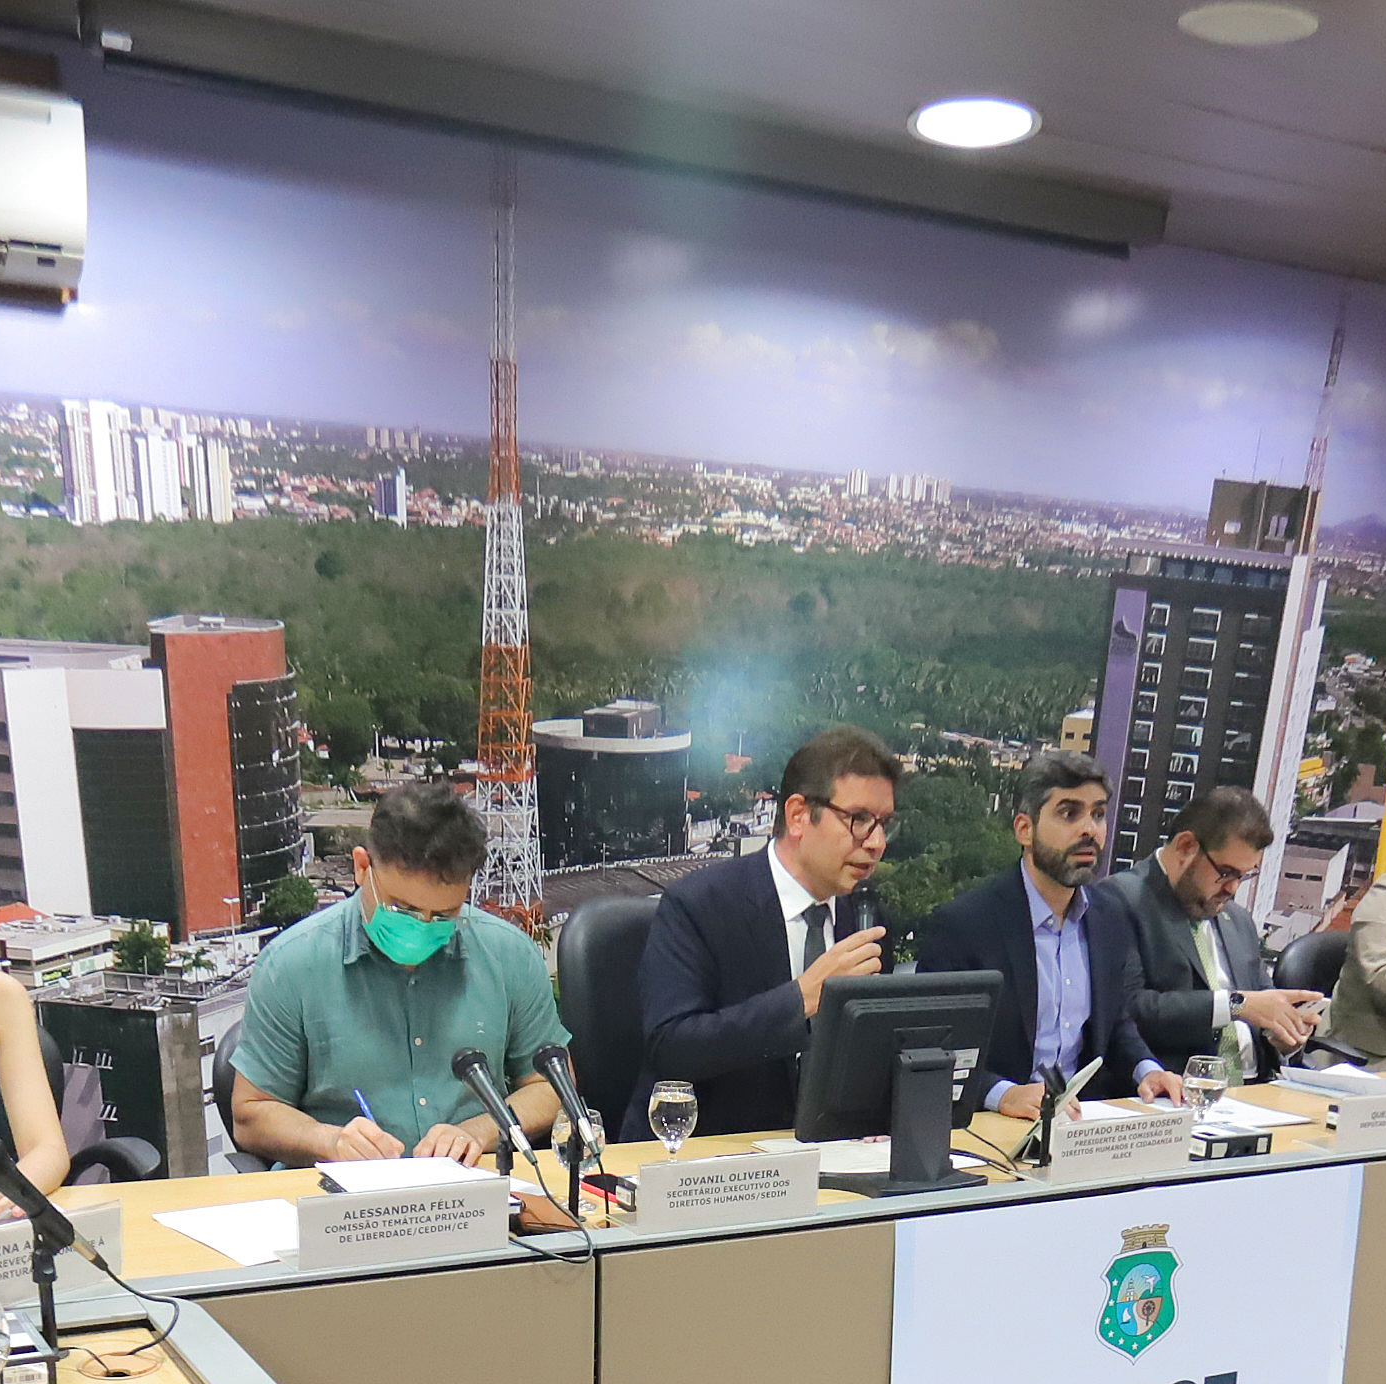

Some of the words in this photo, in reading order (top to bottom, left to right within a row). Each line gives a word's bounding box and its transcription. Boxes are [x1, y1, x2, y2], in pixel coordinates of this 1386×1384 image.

[1067, 1125, 1112, 1139] DEPUTADO
[1114, 1121, 1147, 1133] RENATO
[1150, 1117, 1183, 1128] ROSENO
[1074, 1135, 1116, 1148] PRESIDENTE
[1117, 1134, 1127, 1142] DA
[1128, 1129, 1163, 1140] COMISSÃO
[1164, 1128, 1173, 1136] DE
[1061, 1148, 1094, 1158] DIREITOS
[1095, 1143, 1128, 1154] HUMANOS
[1135, 1138, 1172, 1148] CIDADANIA
[678, 1175, 726, 1187] JOVANIL
[729, 1169, 780, 1182] OLIVEIRA
[666, 1185, 721, 1199] SECRETÁRIO
[723, 1181, 770, 1193] EXECUTIVO
[772, 1179, 790, 1188] DOS
[343, 1203, 426, 1220] ALESSANDRA
[430, 1198, 465, 1211] FÉLIX
[669, 1198, 711, 1209] DIREITOS
[713, 1190, 787, 1204] HUMANOS/SEDIH
[325, 1218, 379, 1234] COMISSÃO
[382, 1213, 431, 1228] TEMÁTICA
[435, 1208, 486, 1222] PRIVADOS
[339, 1234, 353, 1243] DE
[355, 1222, 469, 1242] LIBERDADE/CEDDH/CE
